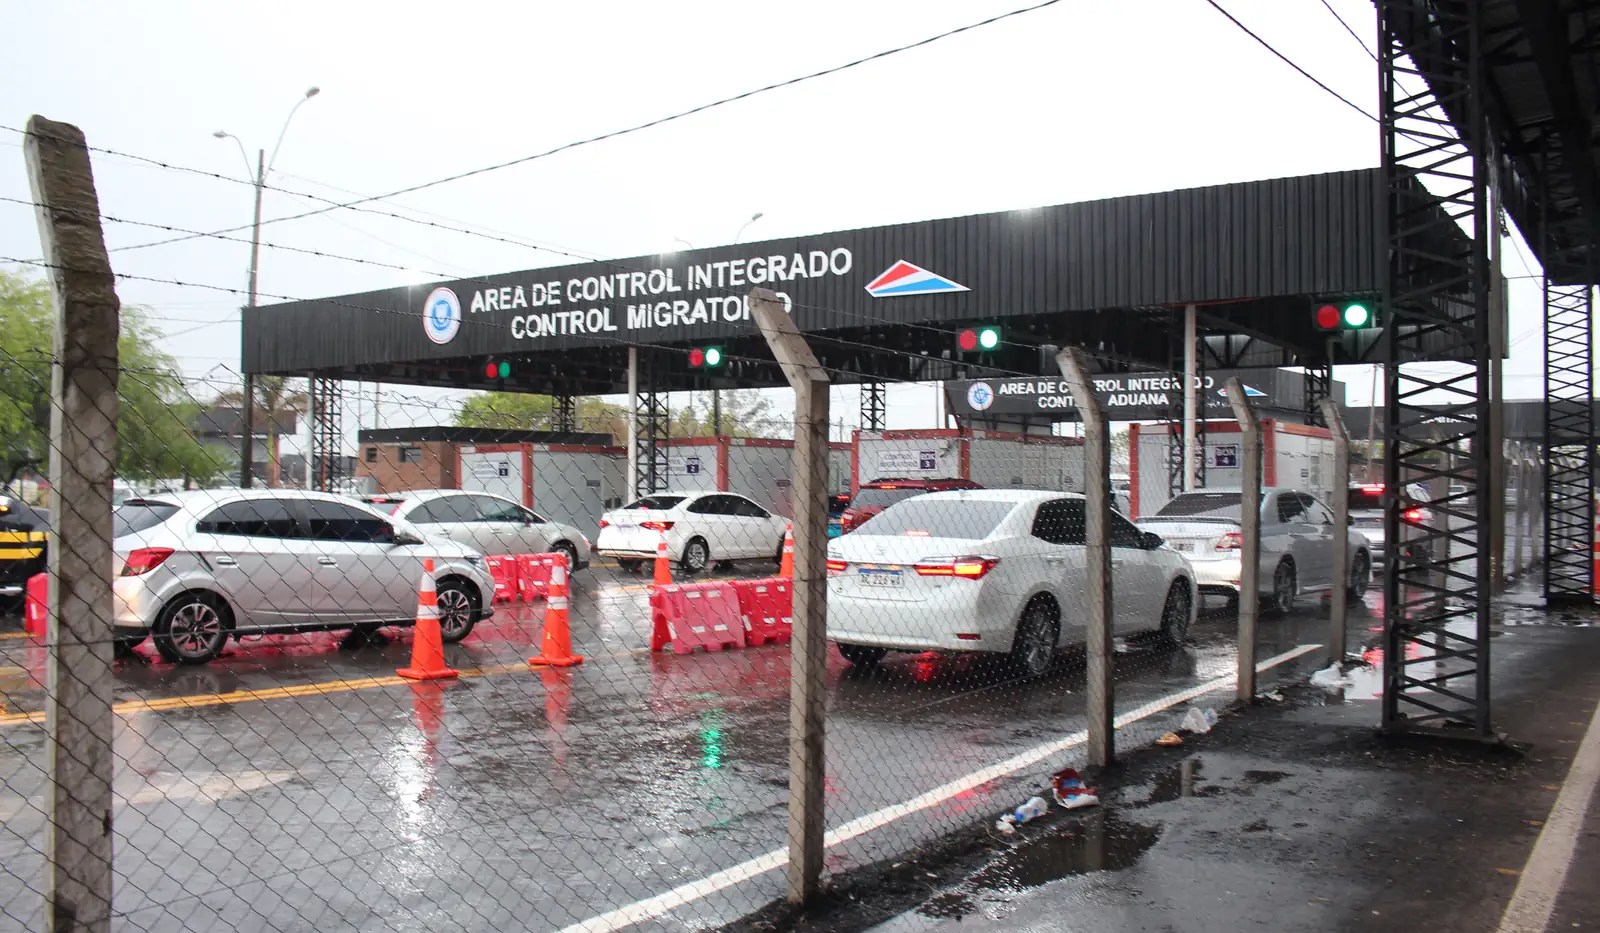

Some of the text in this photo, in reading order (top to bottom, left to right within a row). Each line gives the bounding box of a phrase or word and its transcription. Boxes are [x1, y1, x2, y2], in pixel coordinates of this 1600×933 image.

[470, 247, 853, 313] AREA DE CONTROL INTEGRADO
[511, 292, 793, 339] CONTROL MIGRATOO
[999, 375, 1214, 395] AREA DE CROL INTEGRDO
[1037, 393, 1170, 408] CONT ADUANA
